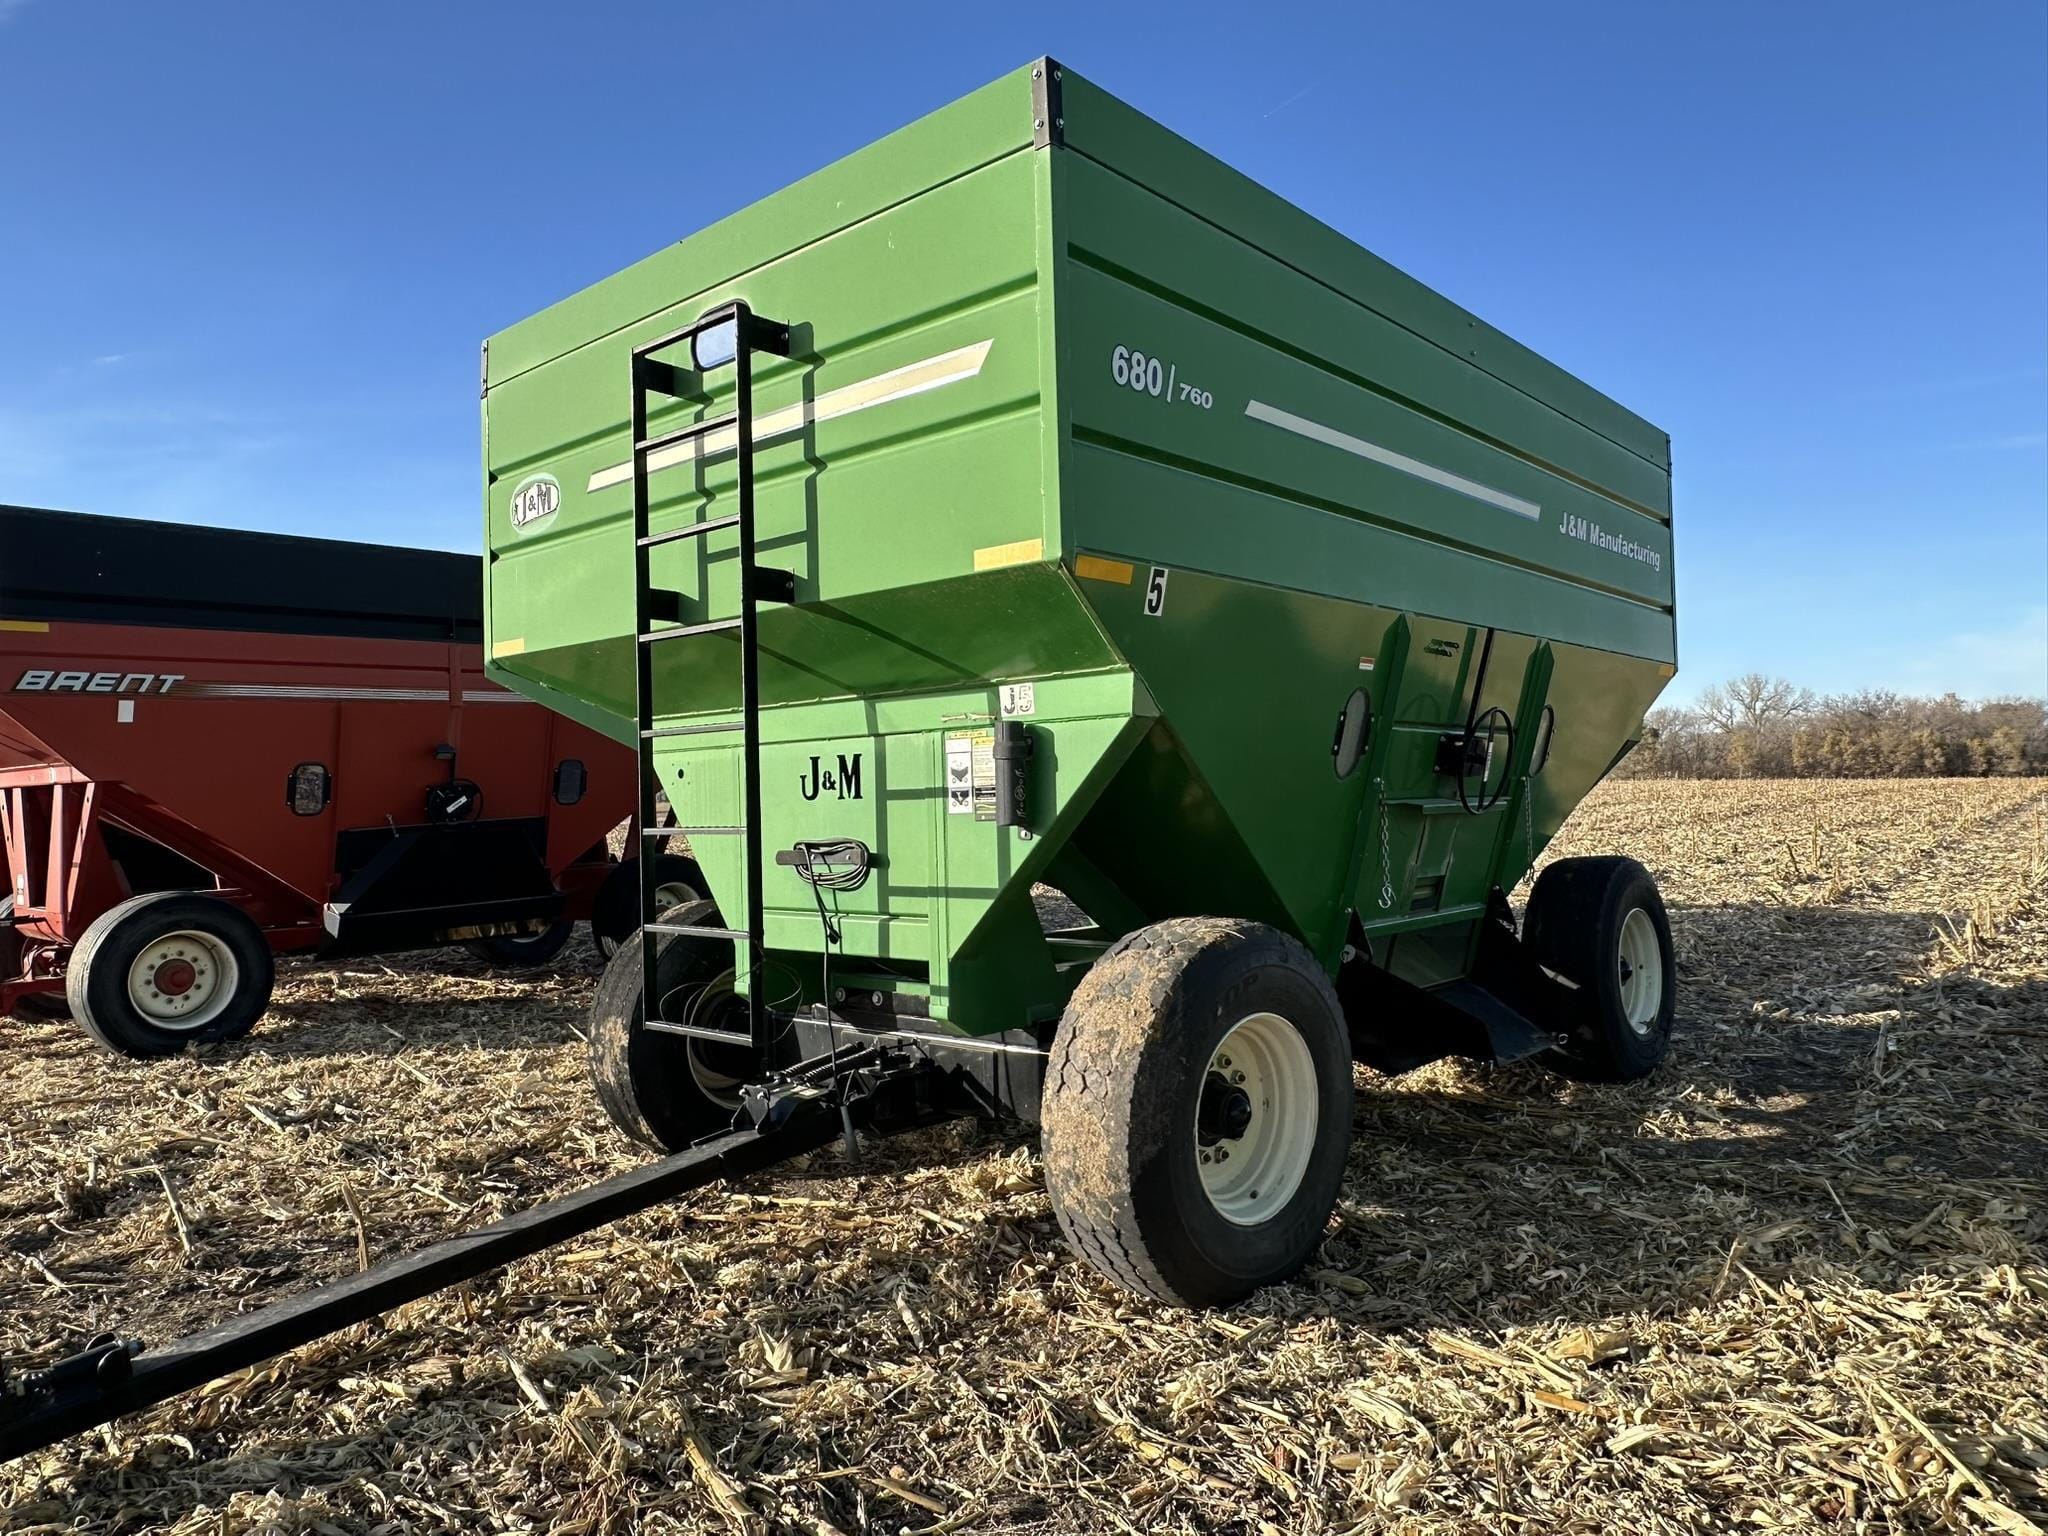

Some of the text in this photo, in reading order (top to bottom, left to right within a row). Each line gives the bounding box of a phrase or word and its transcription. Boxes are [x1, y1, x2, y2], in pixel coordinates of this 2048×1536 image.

[514, 483, 552, 525] J&M
[1590, 522, 1661, 572] Manufacturing
[1147, 568, 1166, 615] 5
[15, 670, 186, 694] BRENT
[799, 753, 863, 801] J&M
